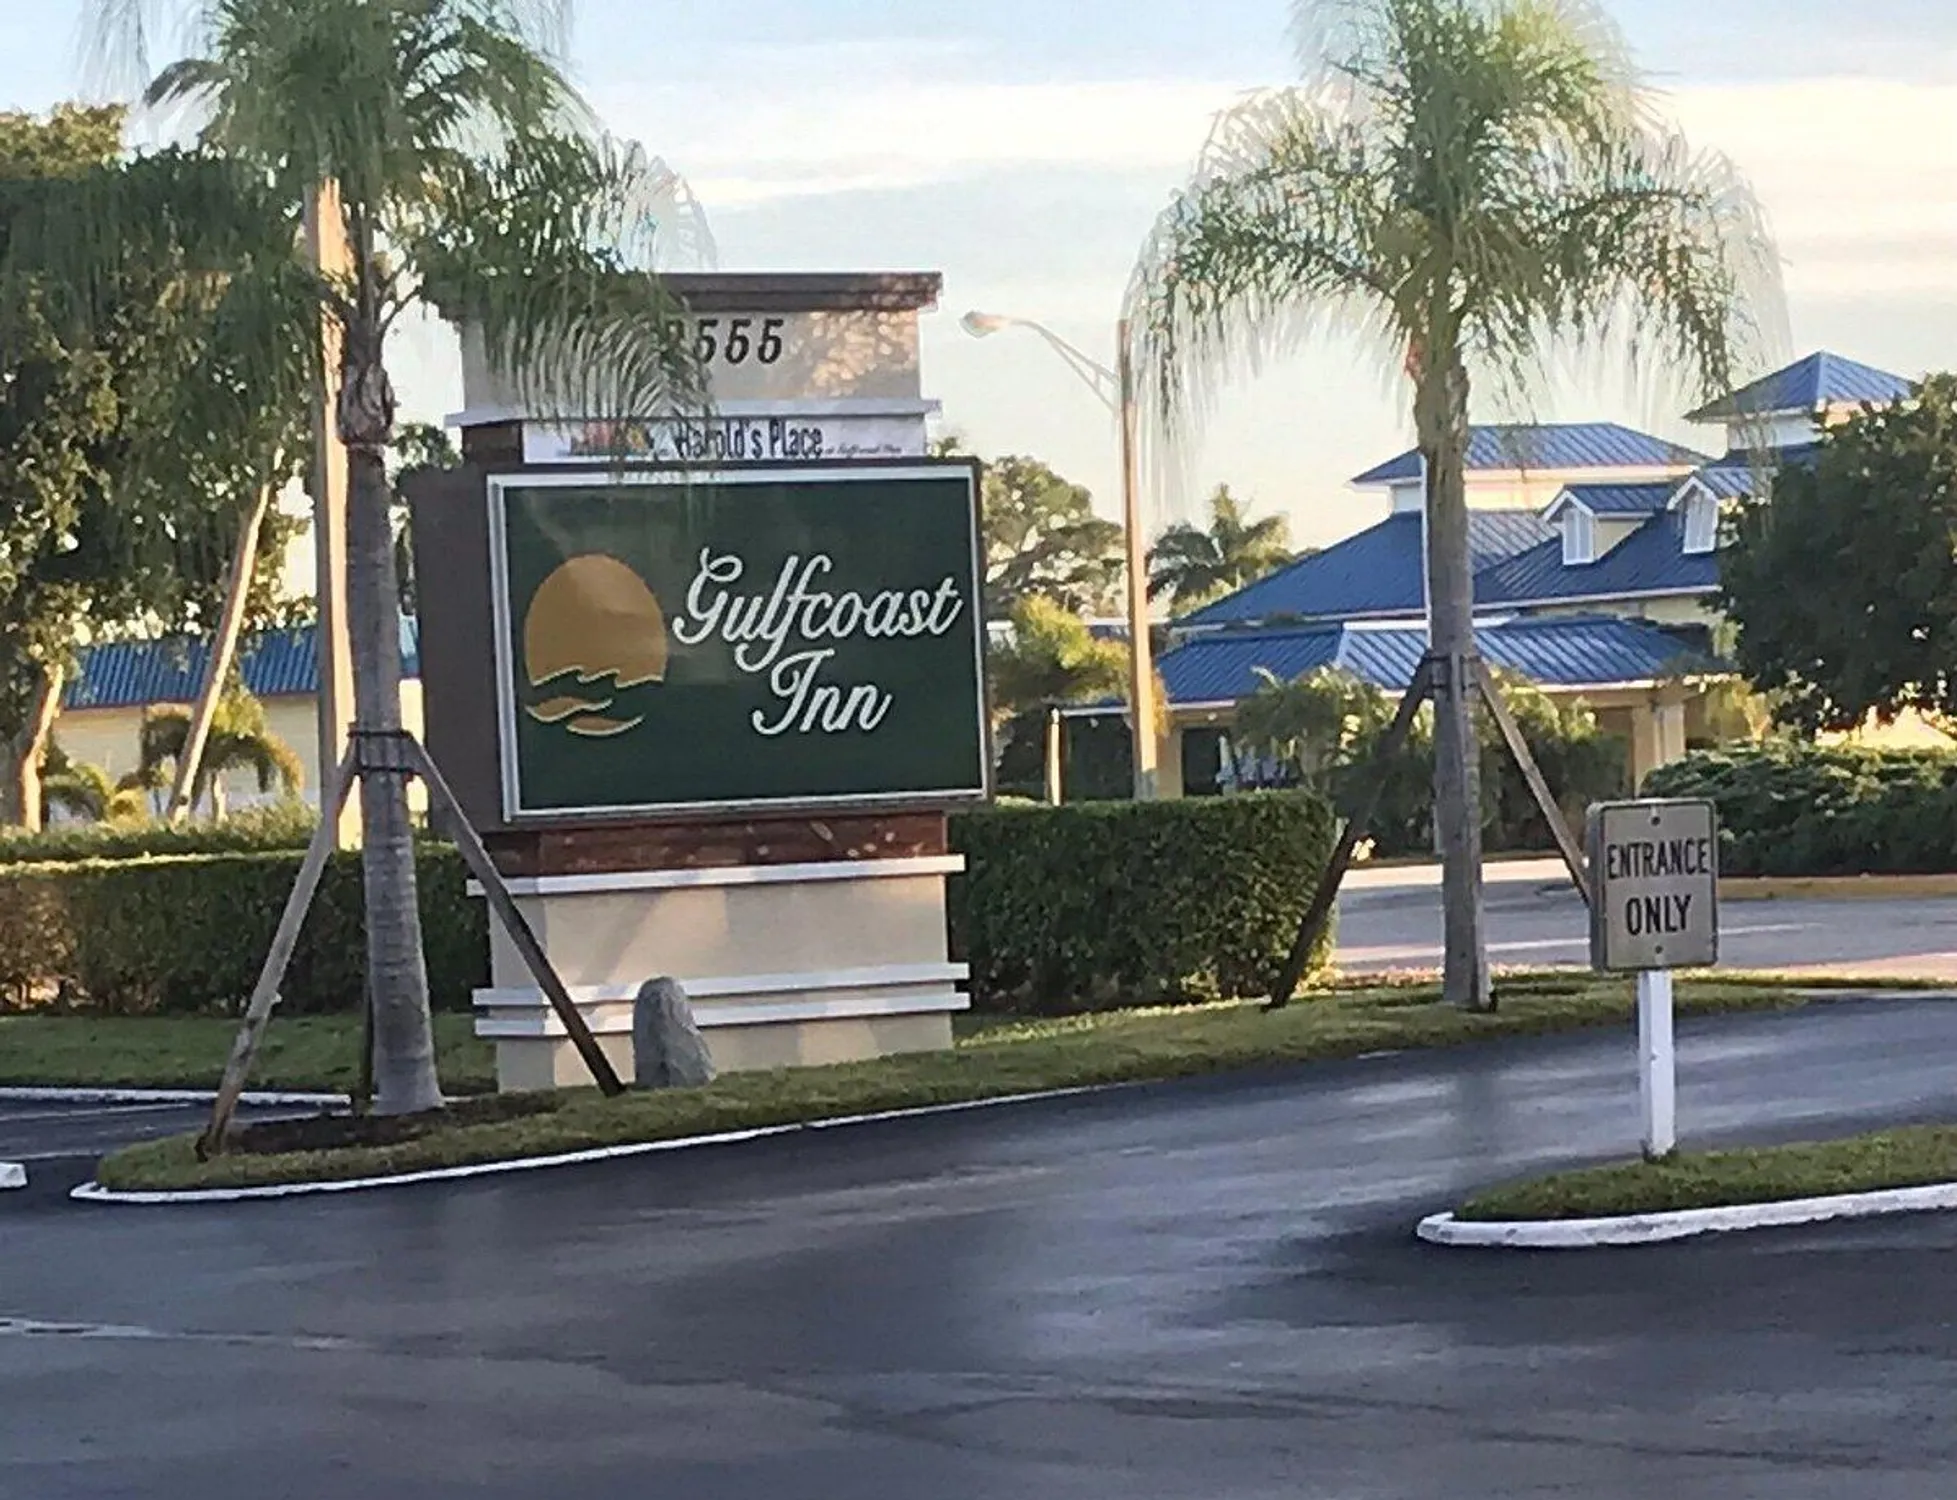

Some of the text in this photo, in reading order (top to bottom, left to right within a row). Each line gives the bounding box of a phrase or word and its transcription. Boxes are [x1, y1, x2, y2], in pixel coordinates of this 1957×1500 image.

[769, 418, 823, 460] Place
[672, 547, 964, 672] Gulfcoast
[752, 648, 893, 735] Inn
[1606, 837, 1710, 880] ENTRANCE
[1625, 894, 1692, 936] ONLY
